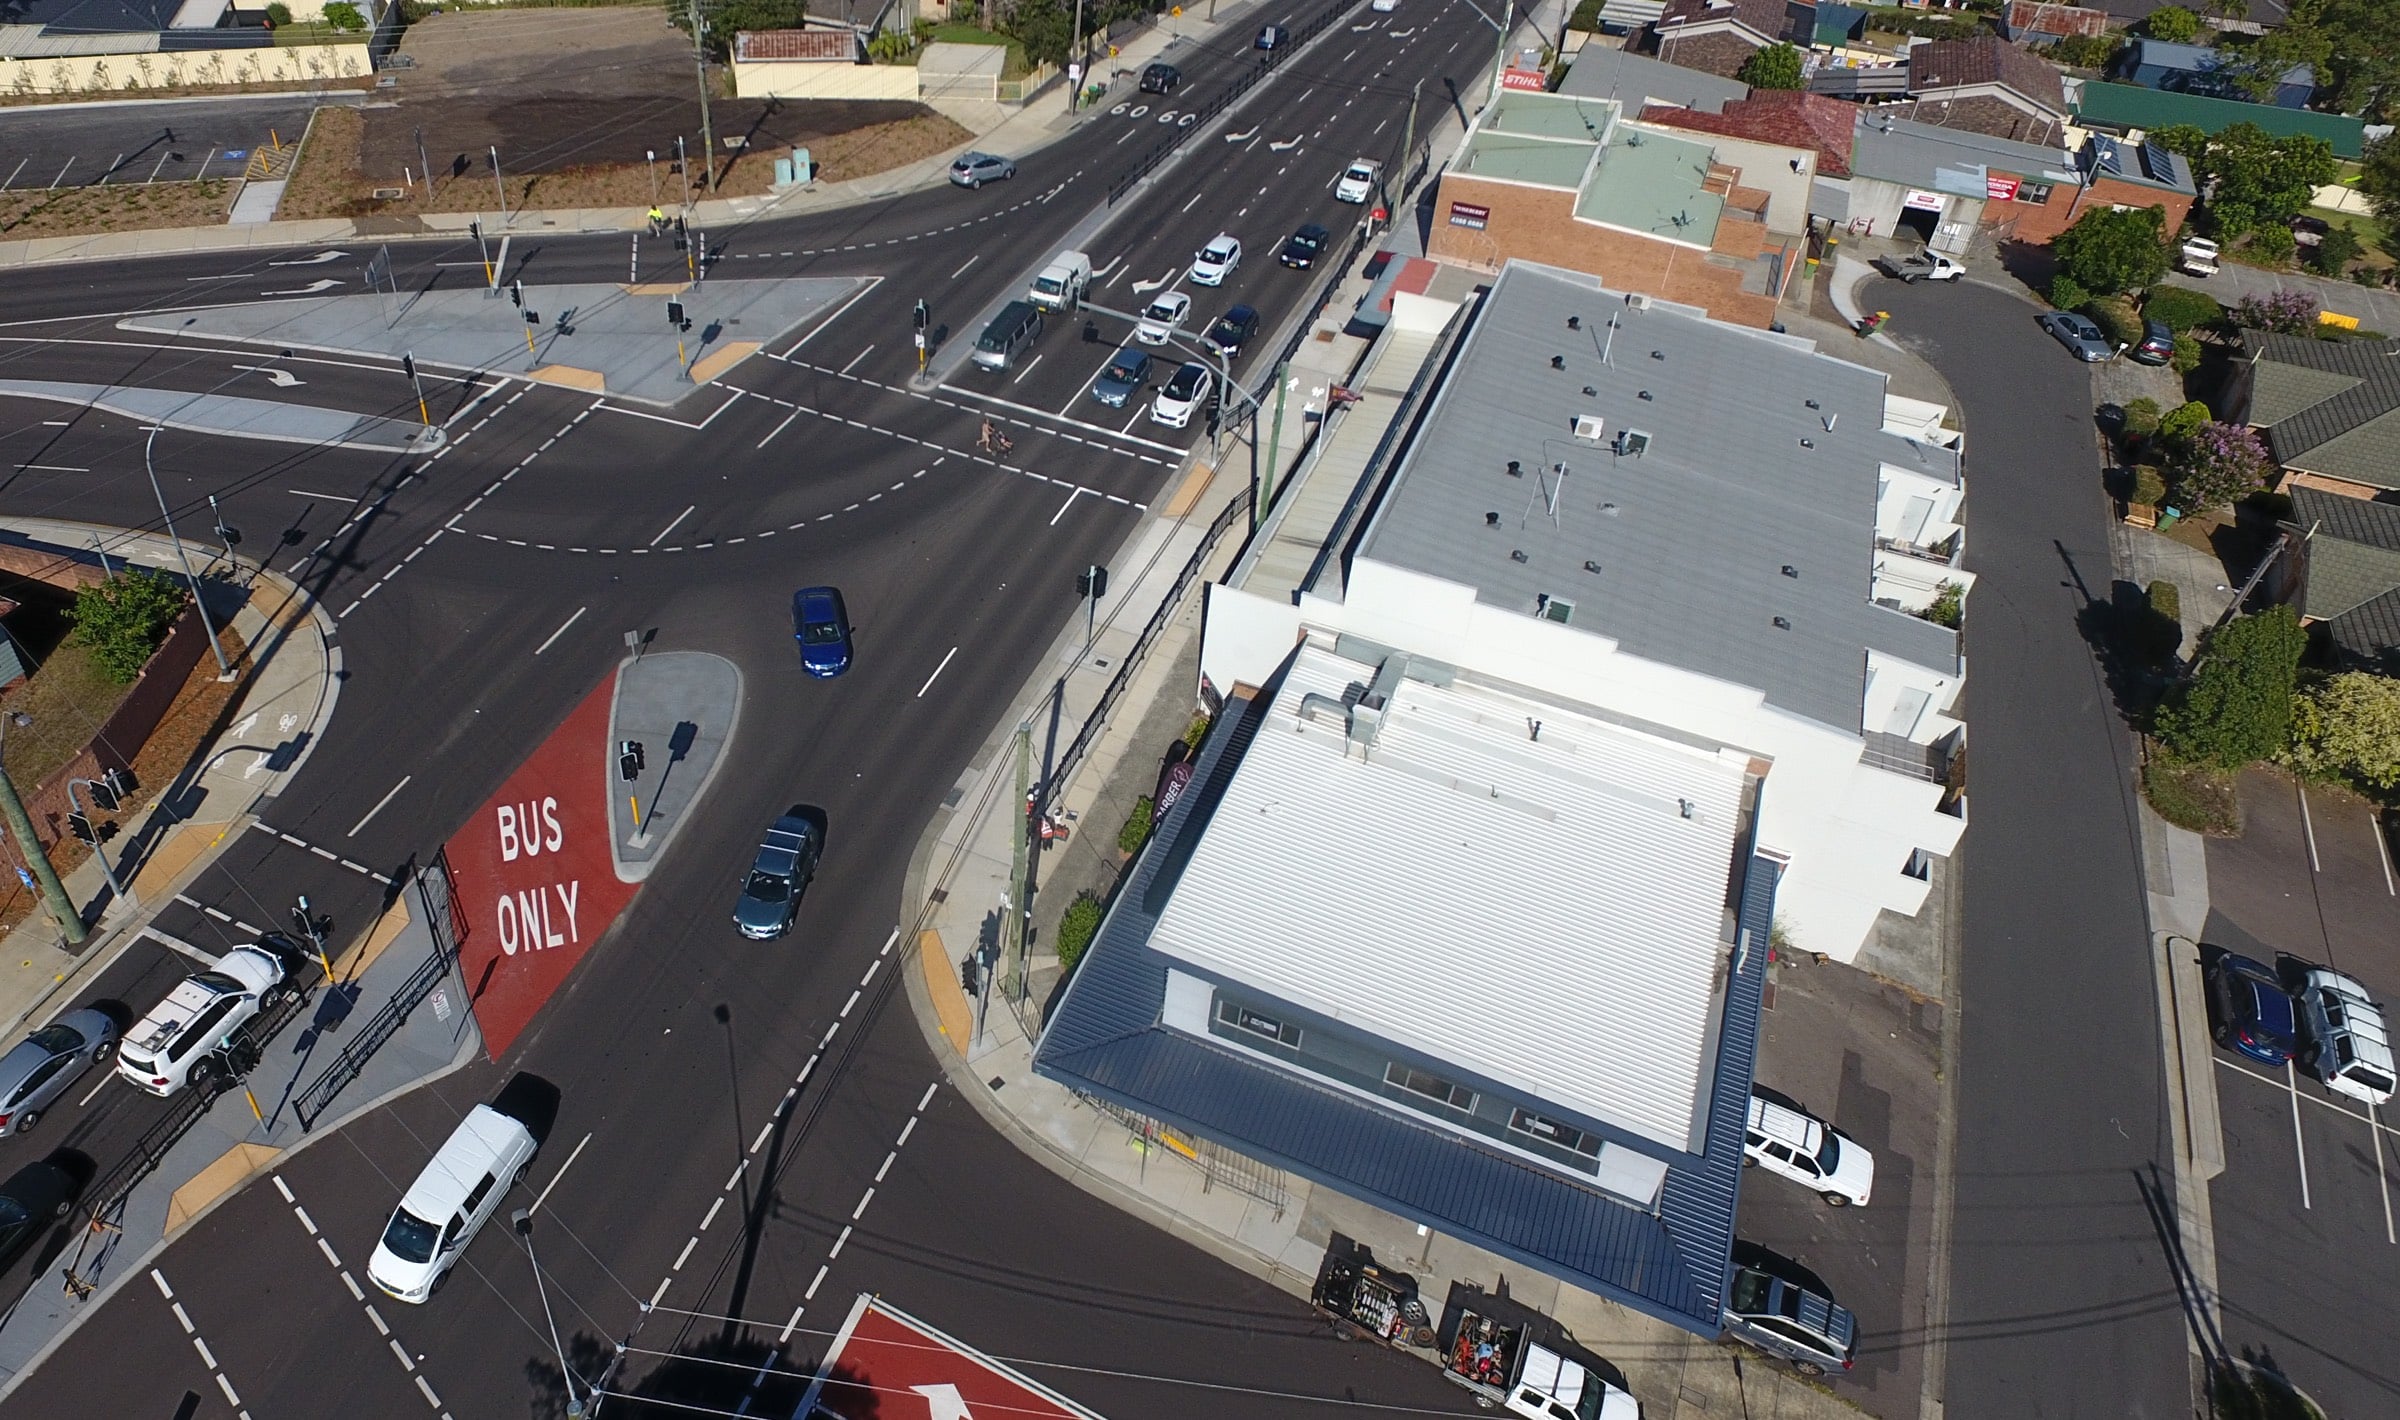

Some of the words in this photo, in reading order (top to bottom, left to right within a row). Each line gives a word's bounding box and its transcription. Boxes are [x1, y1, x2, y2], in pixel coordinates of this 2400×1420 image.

[1504, 74, 1539, 87] STIHL
[1110, 102, 1150, 118] 60
[1158, 110, 1197, 127] 60
[497, 796, 562, 862] BUS
[497, 880, 578, 956] ONLY
